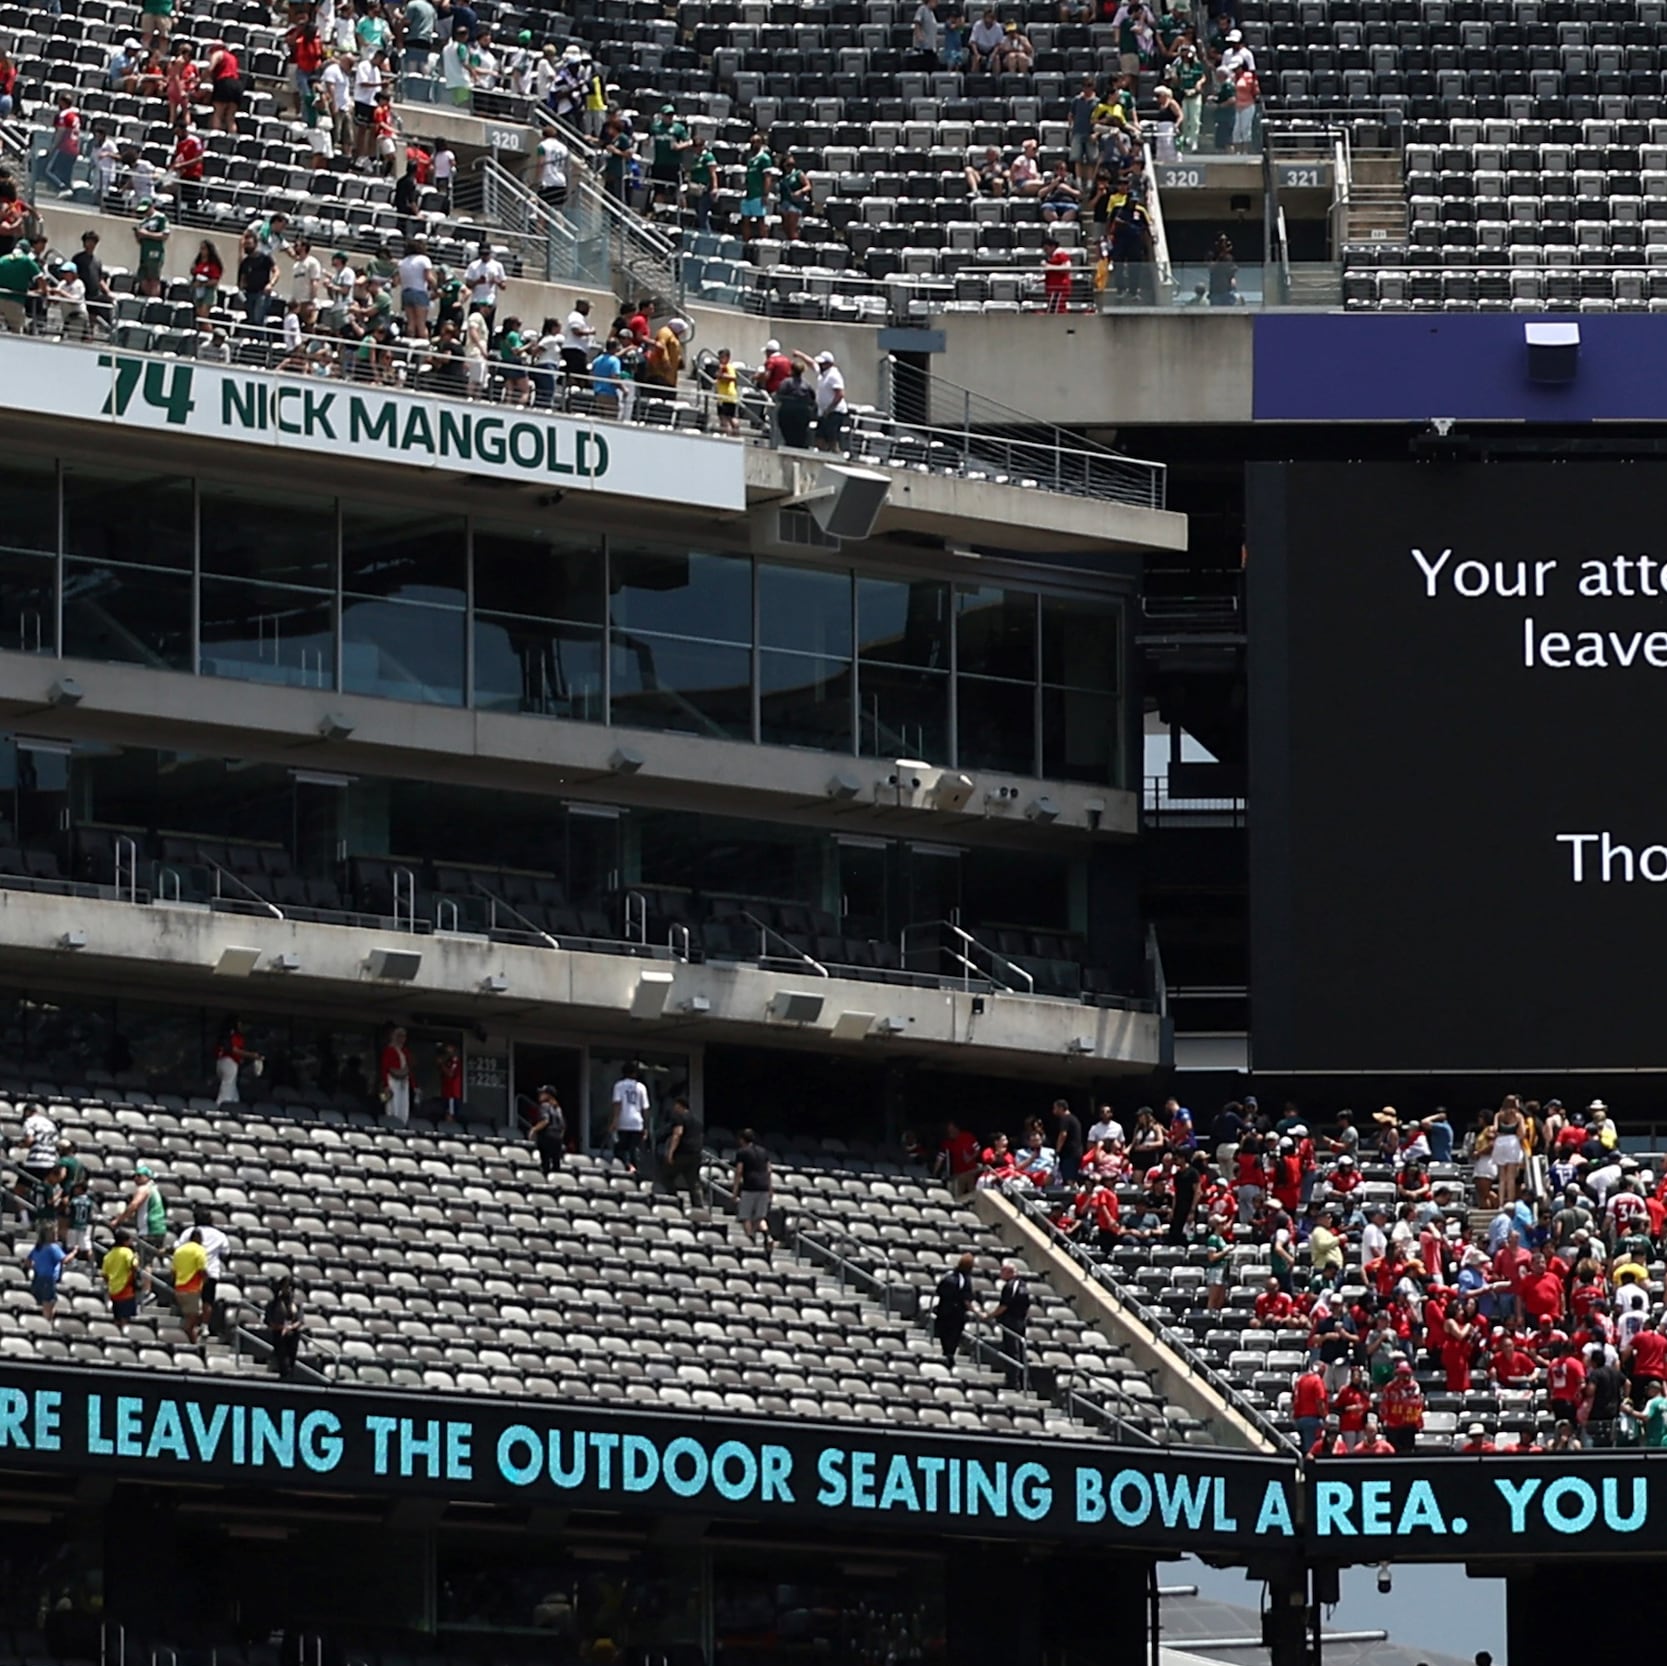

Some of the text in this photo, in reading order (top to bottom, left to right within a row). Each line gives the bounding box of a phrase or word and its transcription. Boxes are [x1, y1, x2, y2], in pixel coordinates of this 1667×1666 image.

[491, 130, 520, 150] 320
[1166, 171, 1199, 187] 320
[1287, 170, 1319, 187] 321
[97, 353, 609, 480] 74 NICK MANGOLD
[1411, 549, 1557, 597] Your
[88, 1395, 343, 1471] LEAVING
[366, 1416, 472, 1479] THE
[498, 1425, 794, 1501] OUTDOOR
[818, 1448, 1052, 1520] SEATING
[1077, 1468, 1236, 1531] BOWL
[1495, 1477, 1647, 1533] YOU
